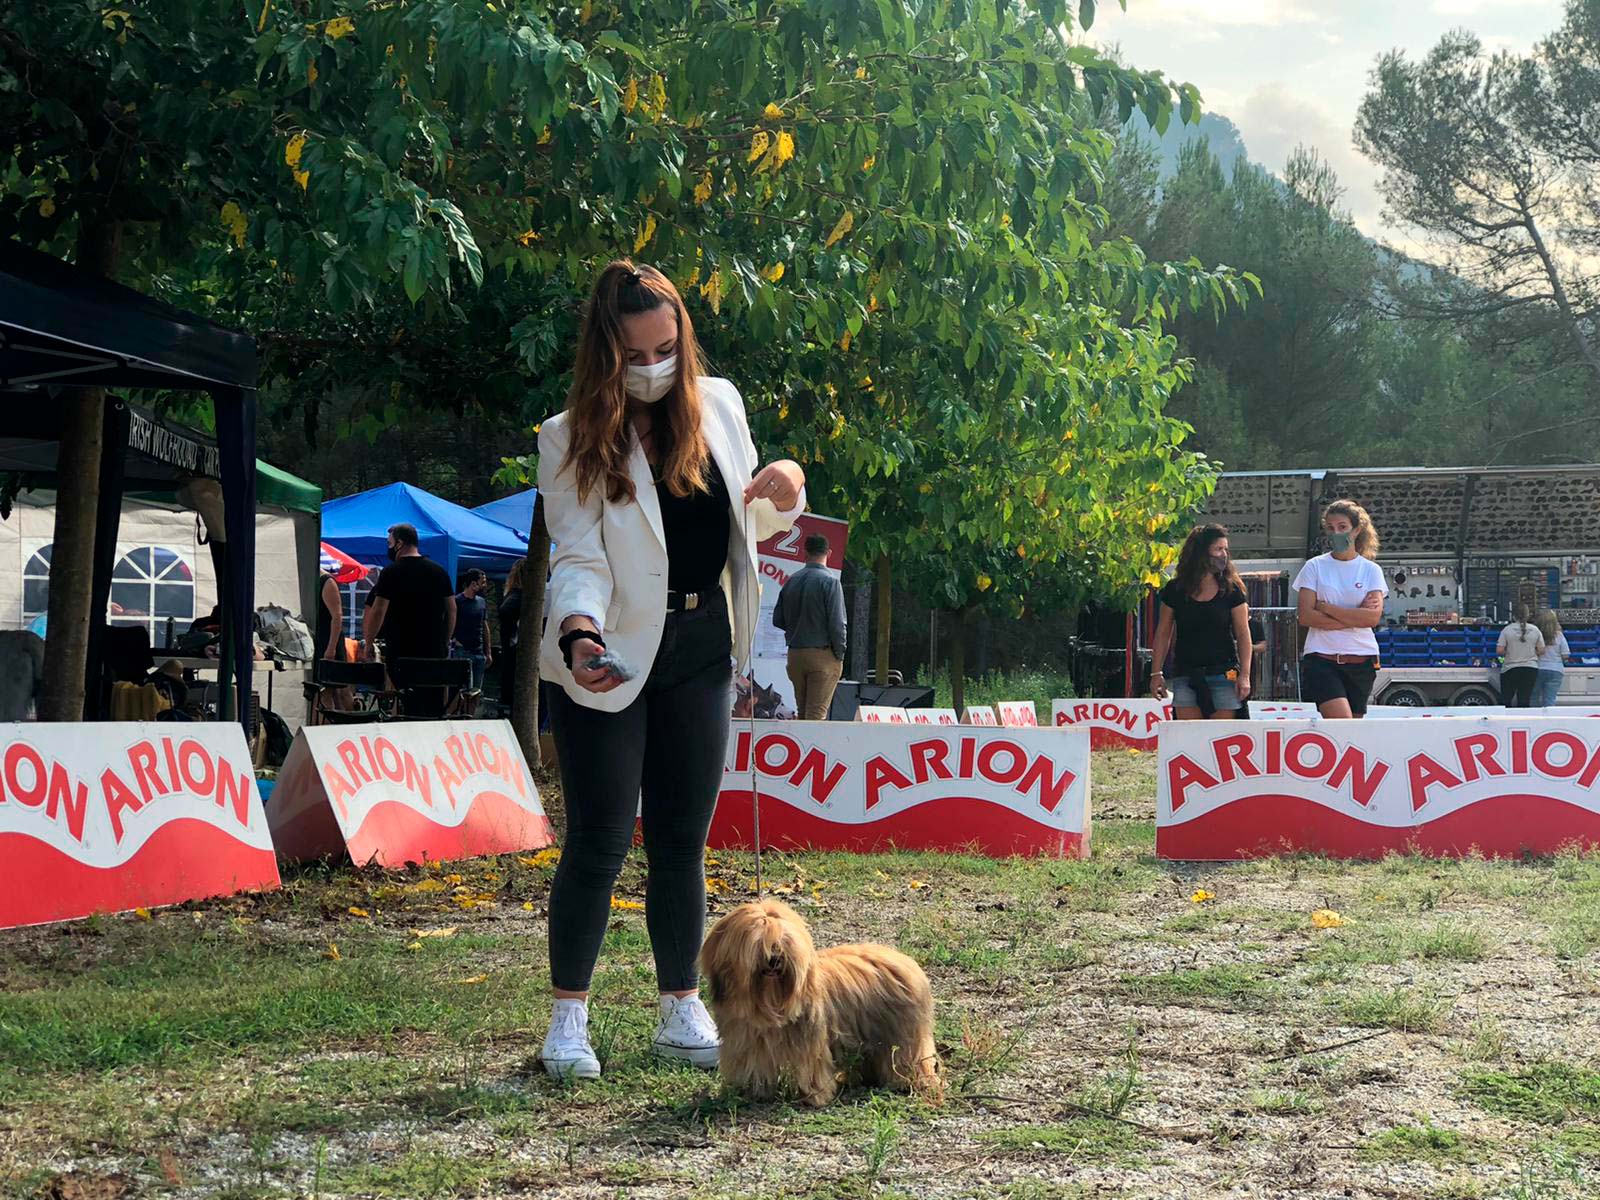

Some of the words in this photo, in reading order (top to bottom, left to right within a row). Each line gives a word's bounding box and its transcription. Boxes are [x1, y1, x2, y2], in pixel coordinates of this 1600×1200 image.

[128, 408, 153, 454] IRISH
[152, 422, 198, 471] WOLFHOUND
[758, 560, 790, 586] ION
[774, 523, 802, 555] 2
[1056, 703, 1138, 731] ARION
[1145, 704, 1173, 732] AR
[0, 742, 89, 843] ON
[100, 737, 250, 846] ARION
[323, 735, 433, 822] ARION
[433, 732, 526, 811] ARION
[725, 732, 848, 805] ION
[866, 738, 1076, 813] ARION
[1168, 731, 1390, 813] ARION
